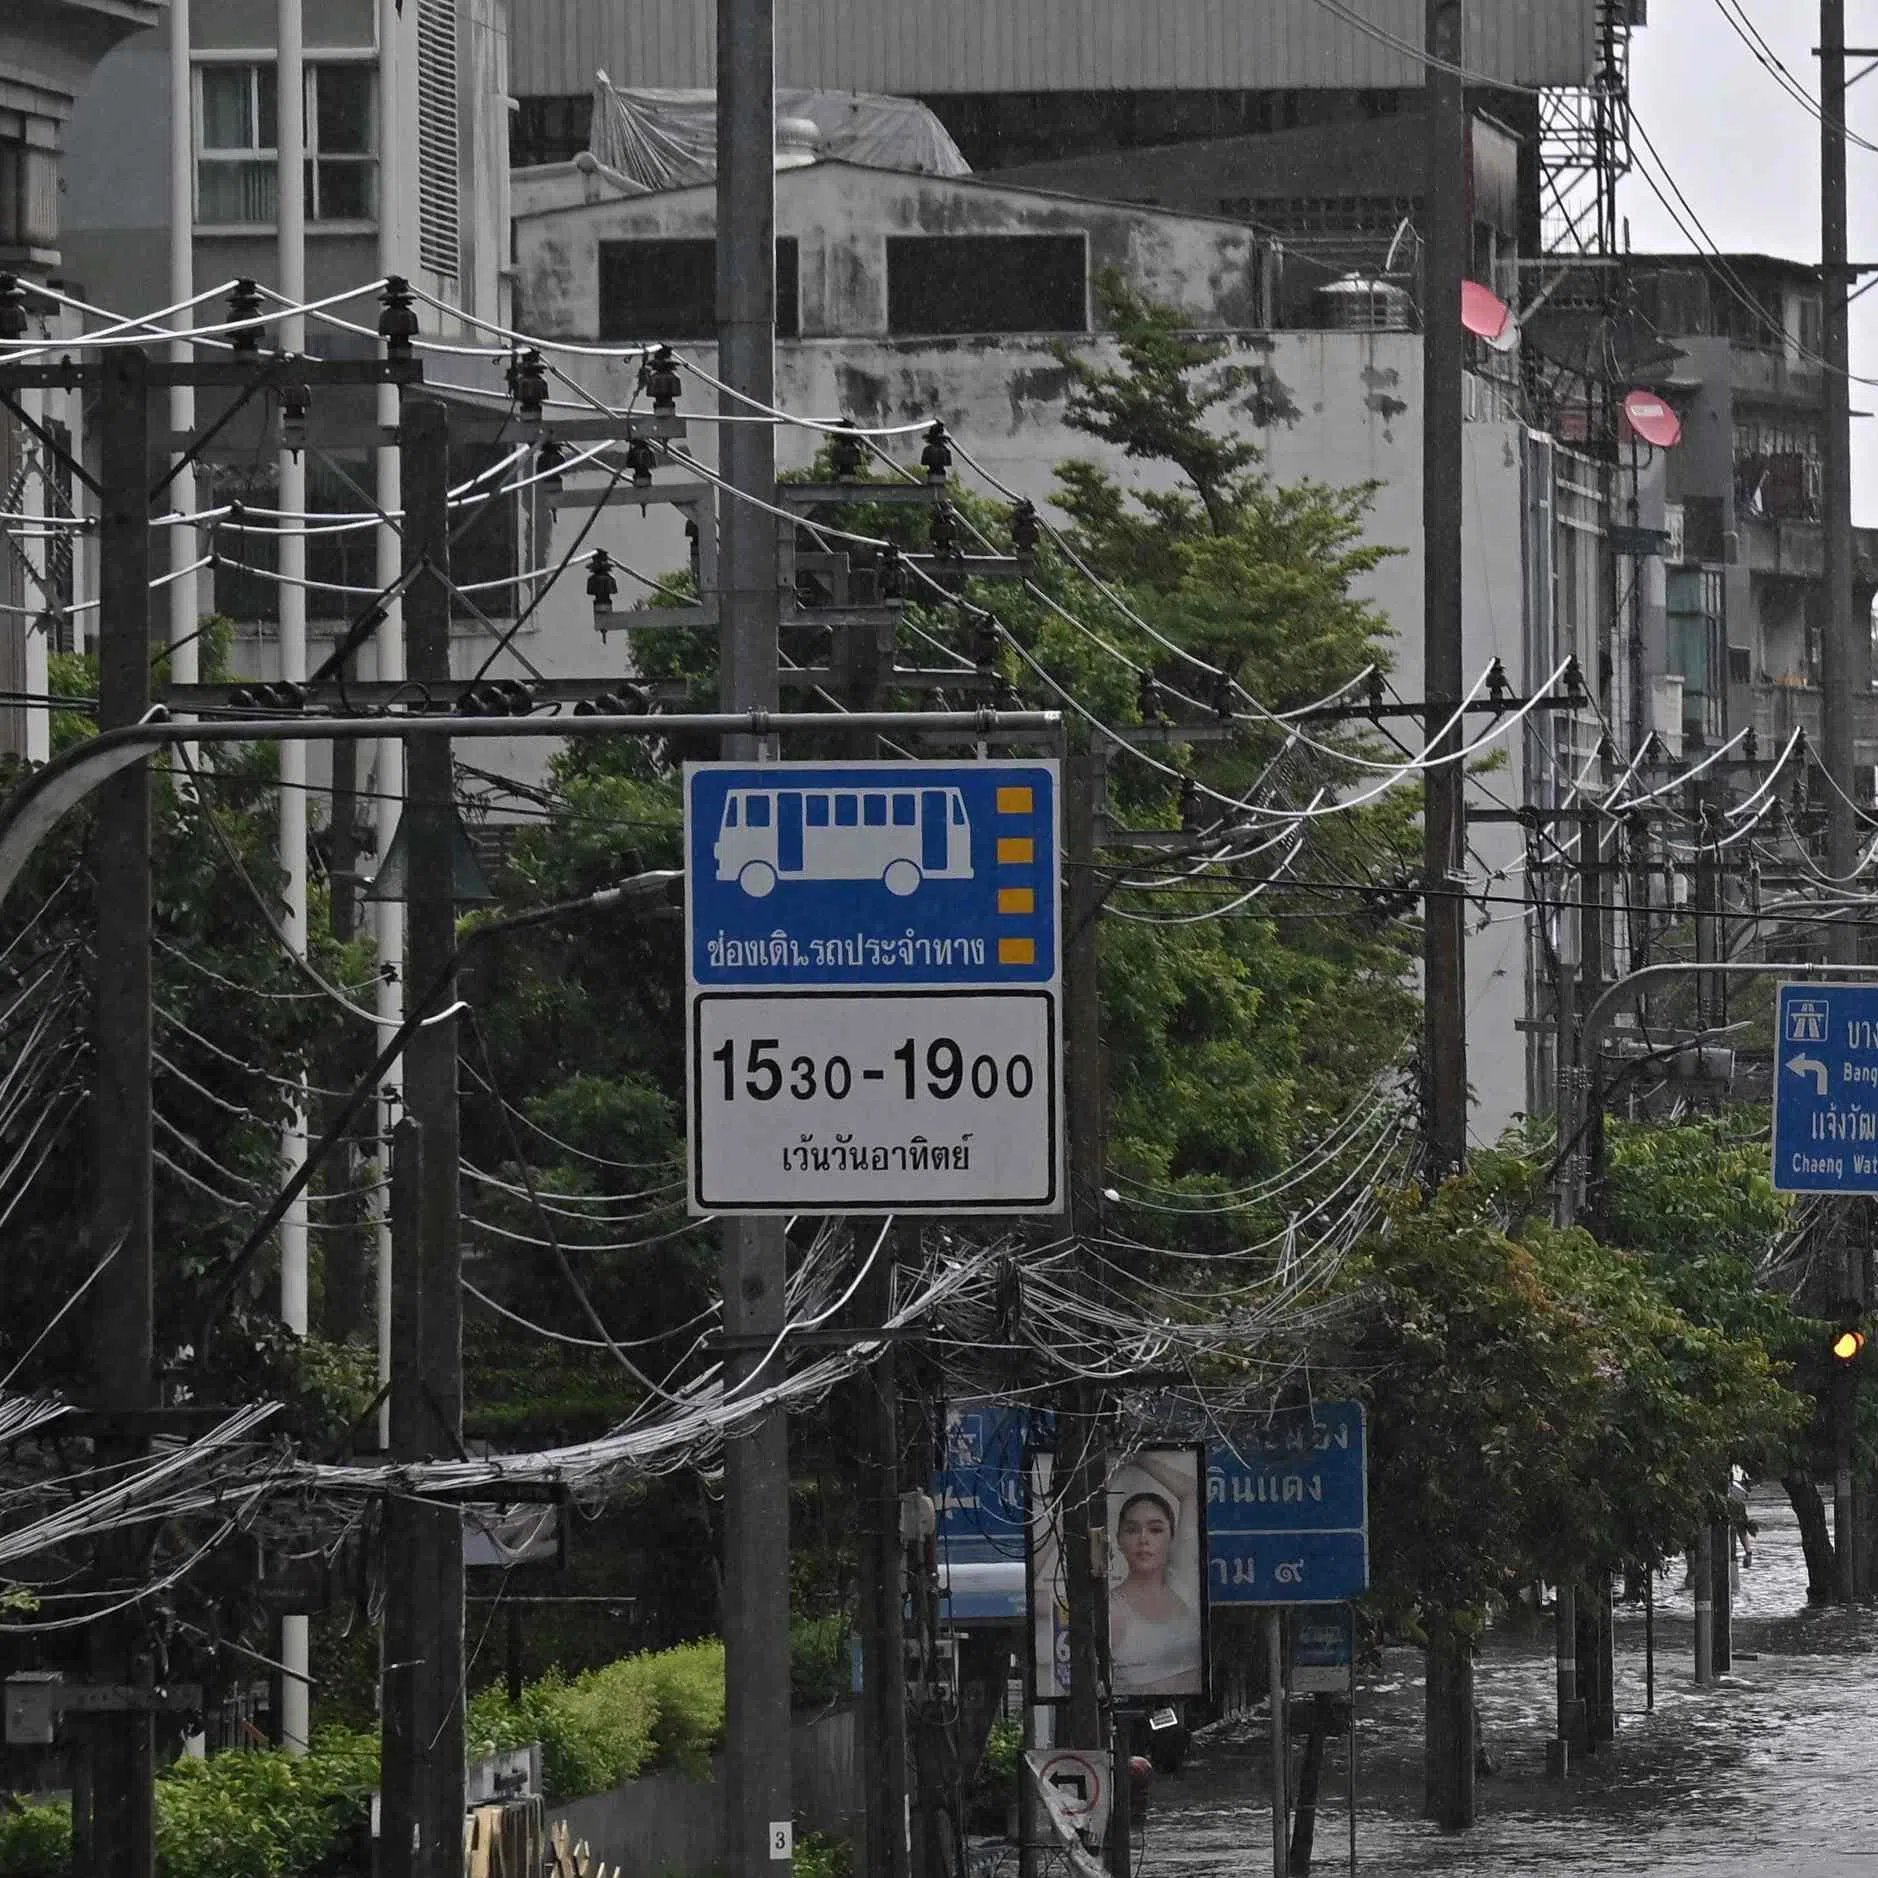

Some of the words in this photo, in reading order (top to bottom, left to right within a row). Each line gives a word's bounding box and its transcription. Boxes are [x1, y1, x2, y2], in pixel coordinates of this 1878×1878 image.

[707, 928, 986, 968] ช่องเดินรถประจำทาง
[1843, 1062, 1878, 1088] Bang
[782, 1133, 974, 1172] เว้นวันอาทิตย์
[1791, 1153, 1844, 1180] Chaeng
[775, 1830, 785, 1850] 3
